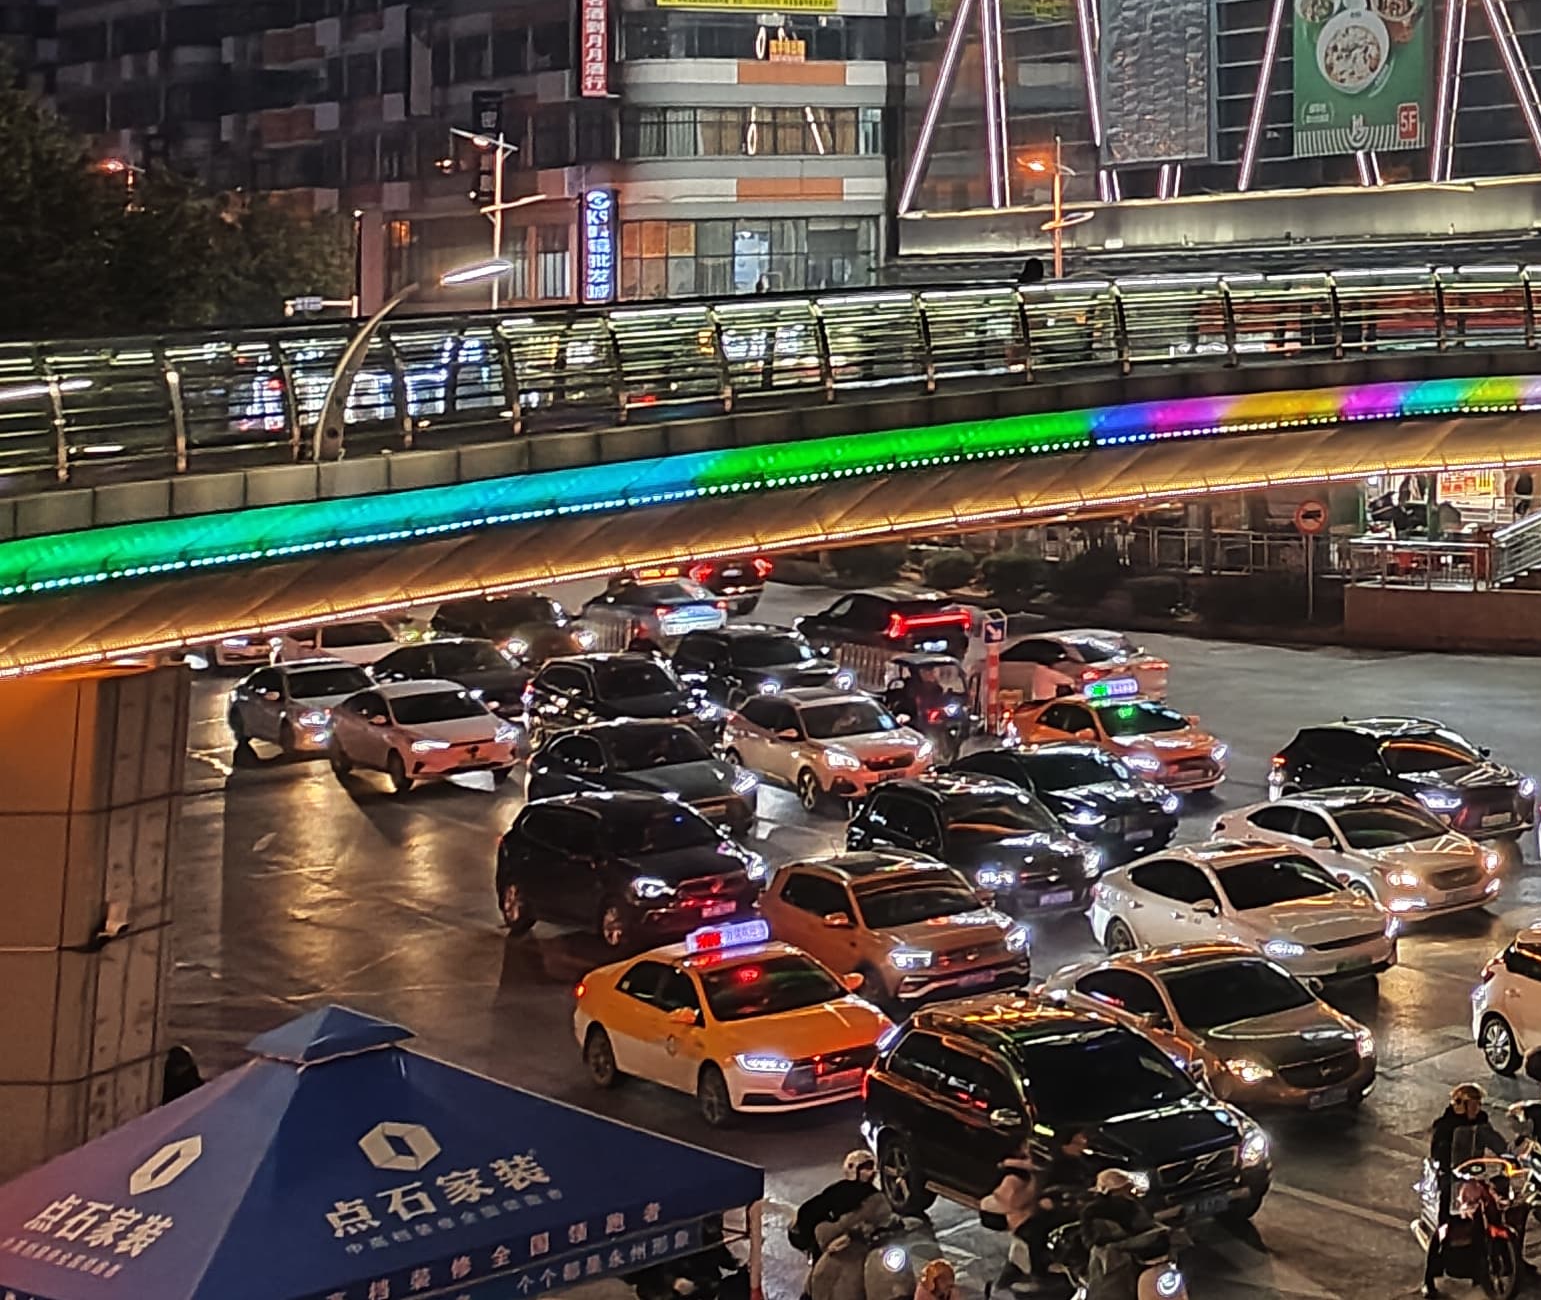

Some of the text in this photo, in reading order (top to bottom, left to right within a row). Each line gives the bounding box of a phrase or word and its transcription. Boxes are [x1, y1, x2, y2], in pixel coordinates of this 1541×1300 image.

[1400, 111, 1417, 133] 5F
[23, 1193, 174, 1258] 点石家装
[325, 1154, 550, 1238] 点石家装
